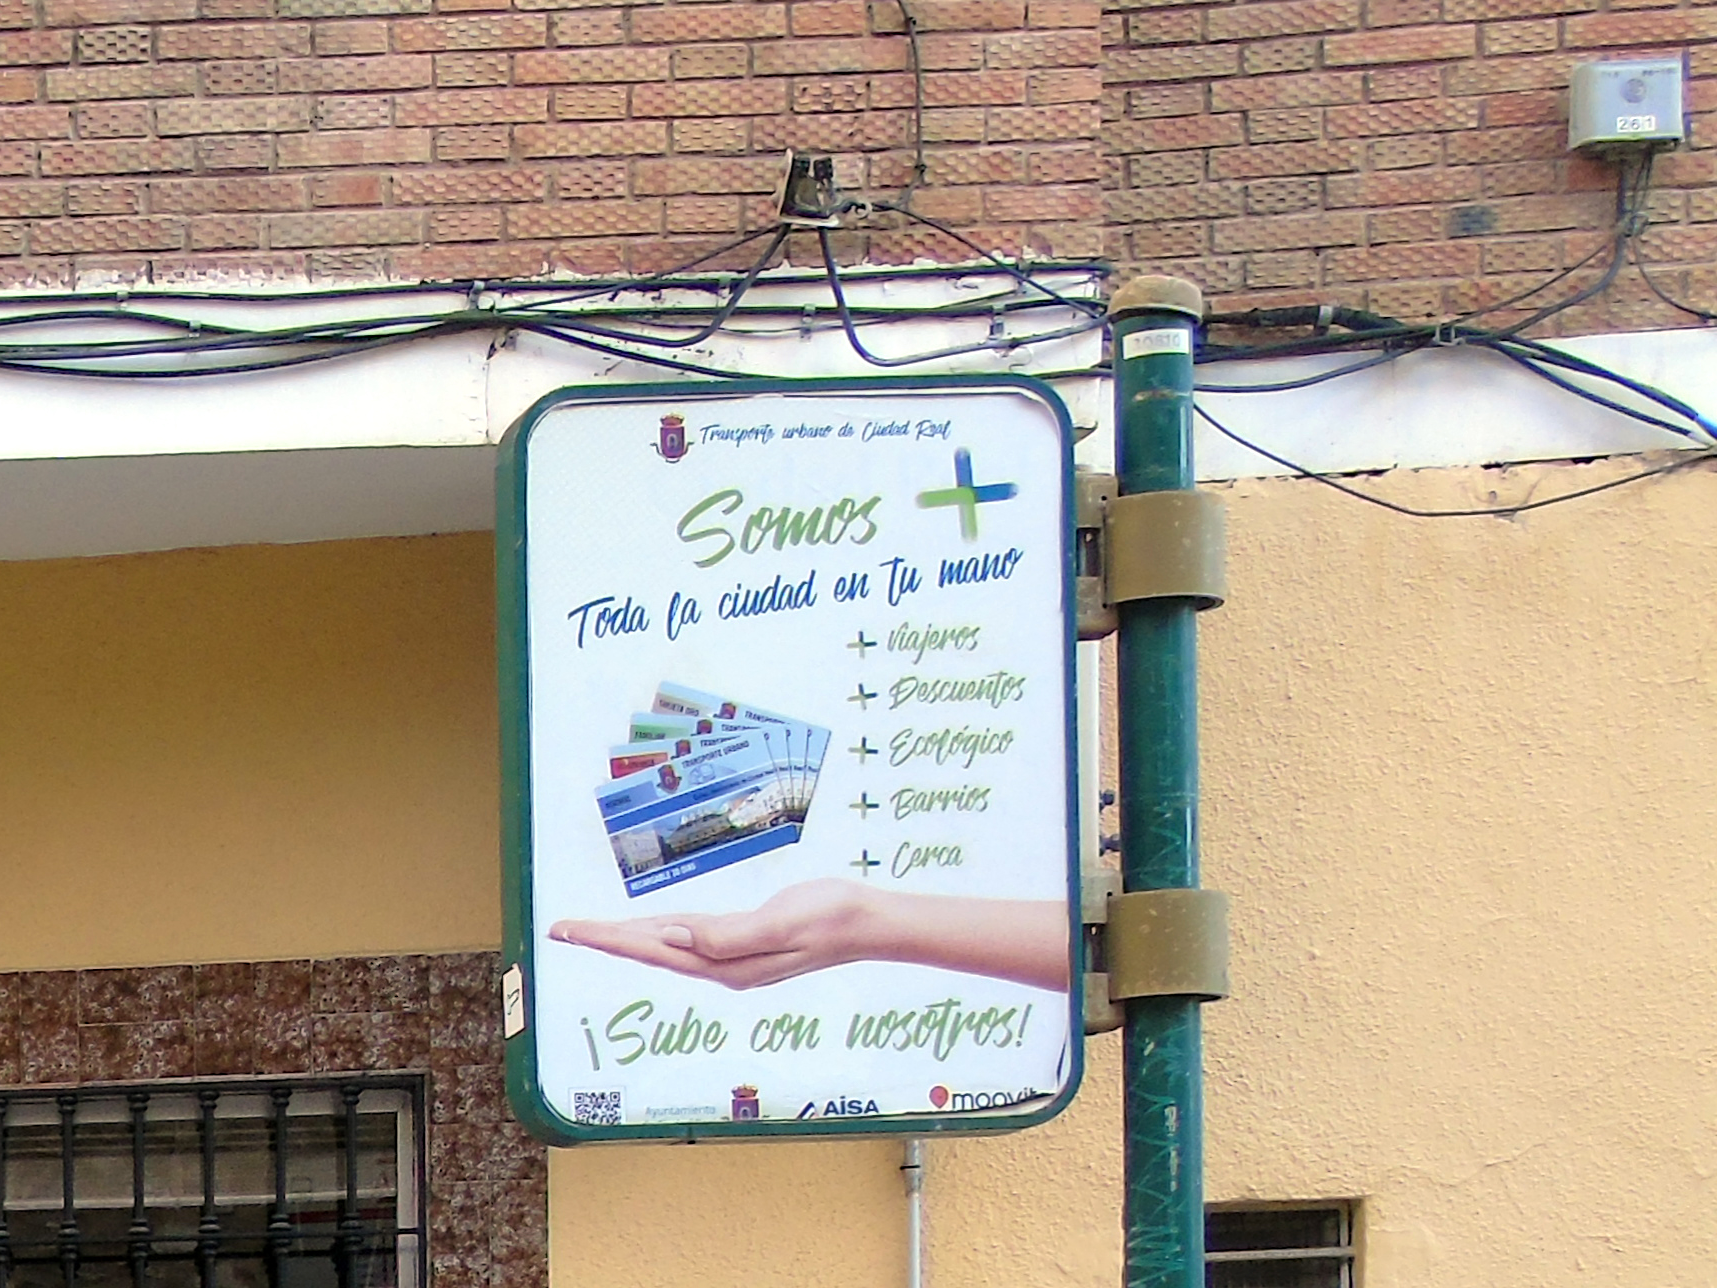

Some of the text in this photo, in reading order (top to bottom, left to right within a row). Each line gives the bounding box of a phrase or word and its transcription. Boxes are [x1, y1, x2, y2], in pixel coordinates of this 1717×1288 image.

[1618, 117, 1653, 131] 261
[699, 418, 952, 448] Transporte urbano de Ciudad Real
[676, 488, 883, 569] Somos
[567, 595, 651, 650] Toda
[666, 595, 701, 641] la
[717, 570, 817, 623] ciudad
[833, 572, 871, 603] en
[938, 544, 1024, 587] mano
[888, 670, 1028, 712] Descuentos
[888, 725, 1015, 771] Ecológico
[889, 785, 991, 821] Barrios
[889, 840, 965, 879] Cerca
[579, 998, 727, 1072] ¡Sube
[748, 1013, 821, 1053] con
[845, 997, 1031, 1063] nosotros!
